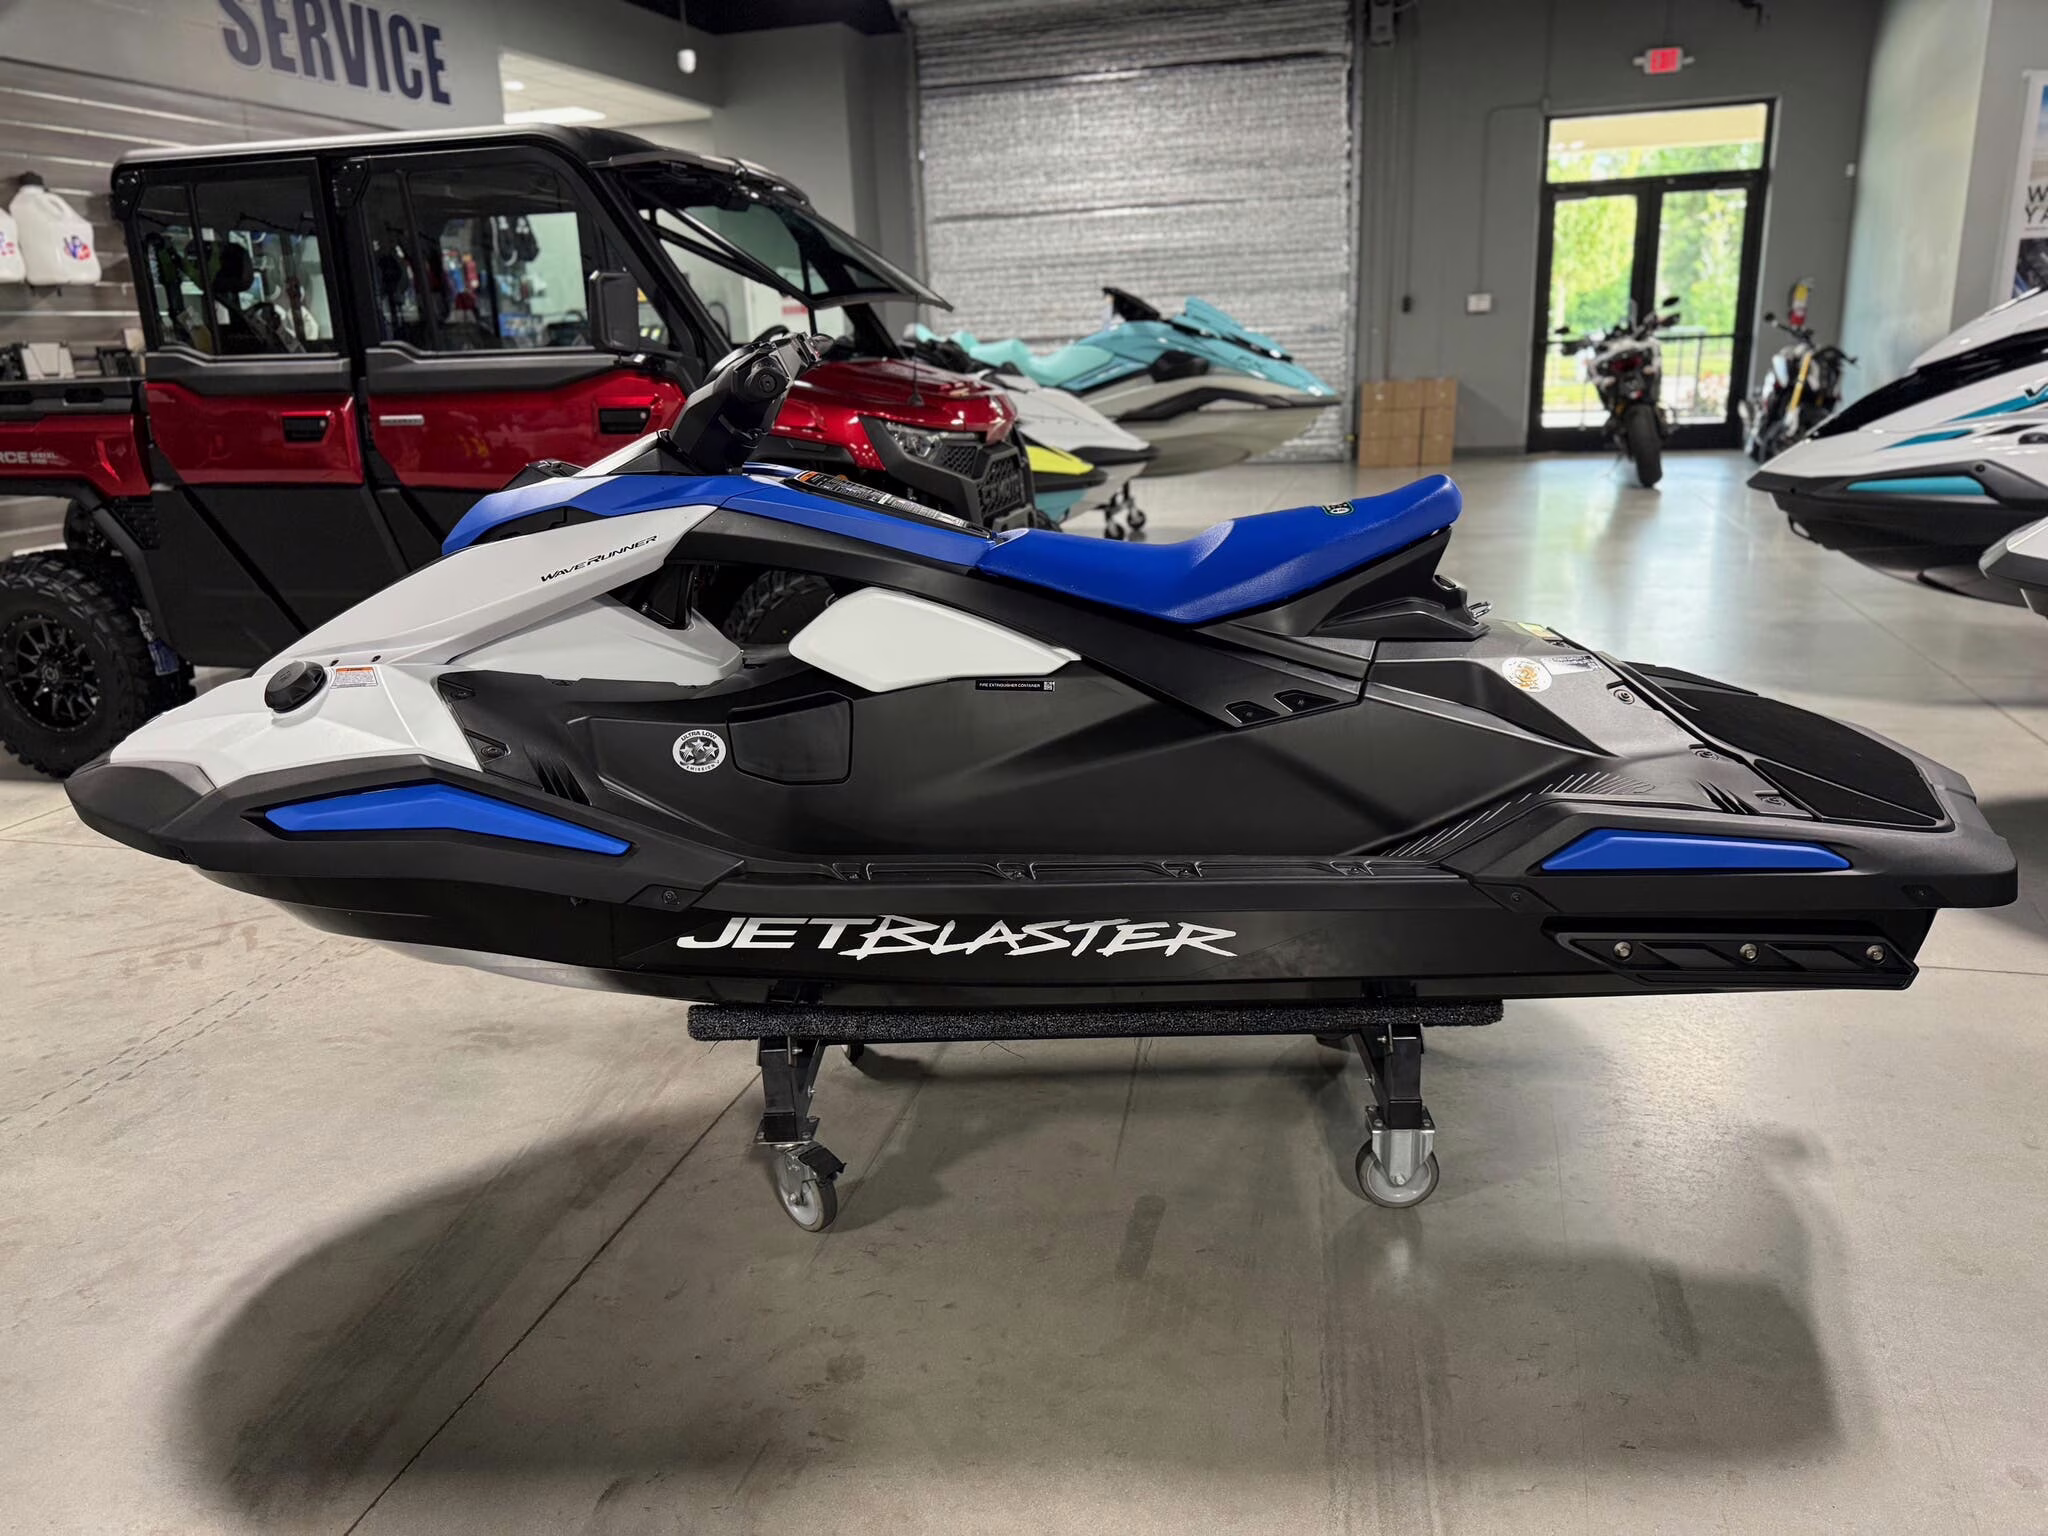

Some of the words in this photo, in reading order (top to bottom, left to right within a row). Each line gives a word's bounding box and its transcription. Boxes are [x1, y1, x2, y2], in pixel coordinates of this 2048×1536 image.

[219, 0, 452, 105] SERVICE
[541, 535, 658, 582] WAVERUNNER
[681, 731, 700, 741] ULTRA
[702, 731, 718, 740] LOW
